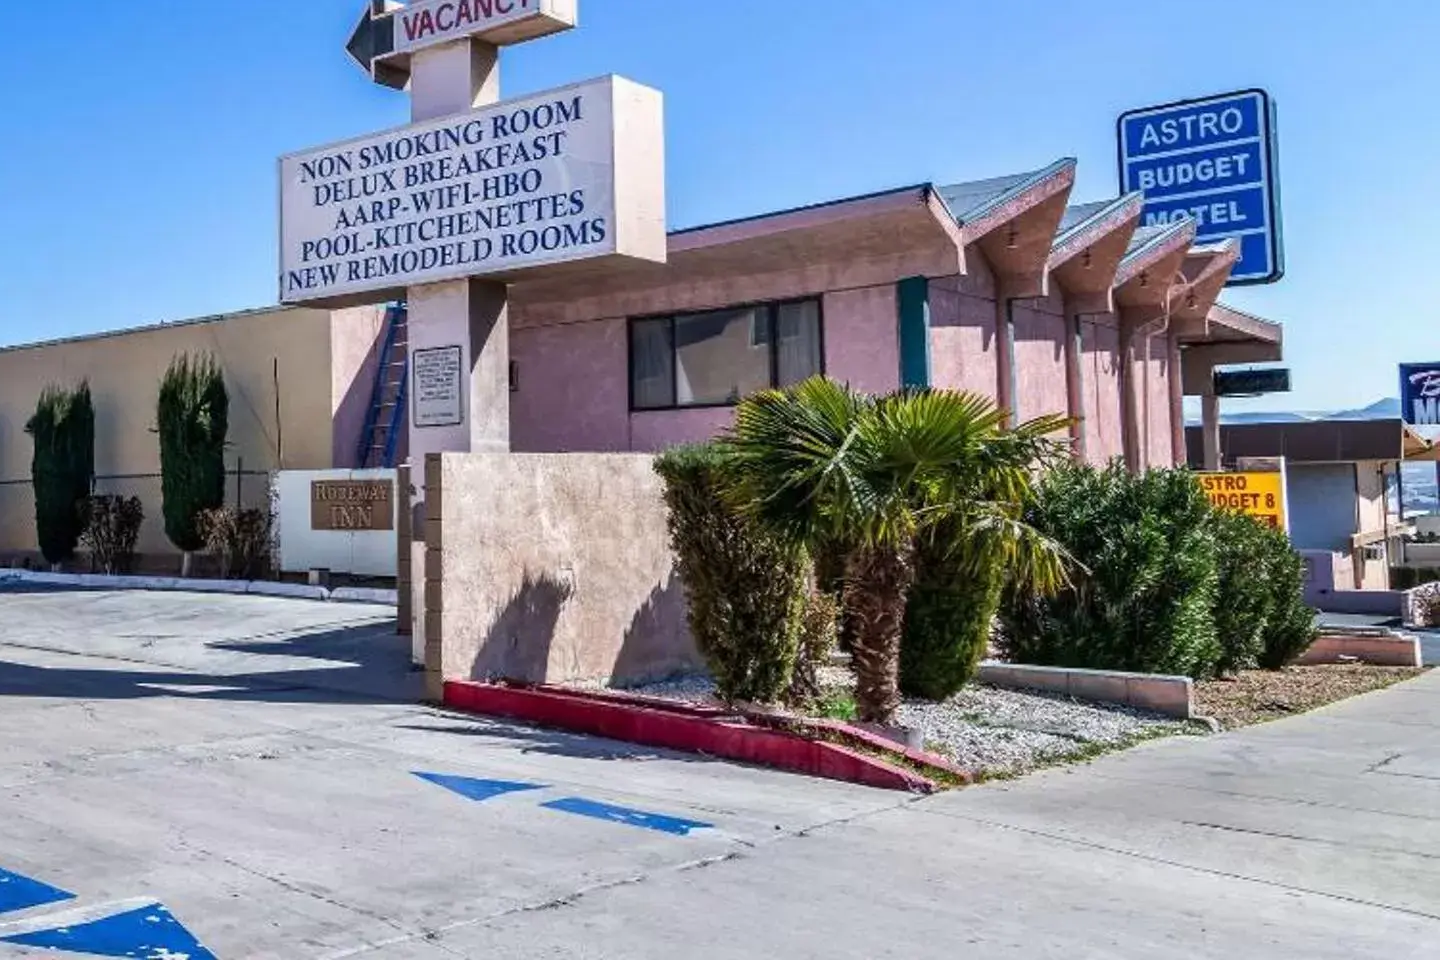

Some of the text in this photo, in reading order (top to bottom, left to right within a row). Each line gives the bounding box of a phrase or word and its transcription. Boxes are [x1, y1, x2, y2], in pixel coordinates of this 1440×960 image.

[300, 96, 582, 183] NON SMOKING ROOM
[1140, 107, 1243, 149] ASTRO
[314, 131, 567, 206] DELUX BREAKFAST
[1138, 153, 1250, 189] BUDGET
[335, 168, 542, 230] AARP-WIFI-HBO
[302, 190, 584, 262] POOL-KITCHENETTES
[287, 218, 606, 291] NEW REMODELD ROOMS
[1199, 476, 1247, 490] STRO
[1265, 493, 1275, 508] 8
[331, 506, 372, 528] INN
